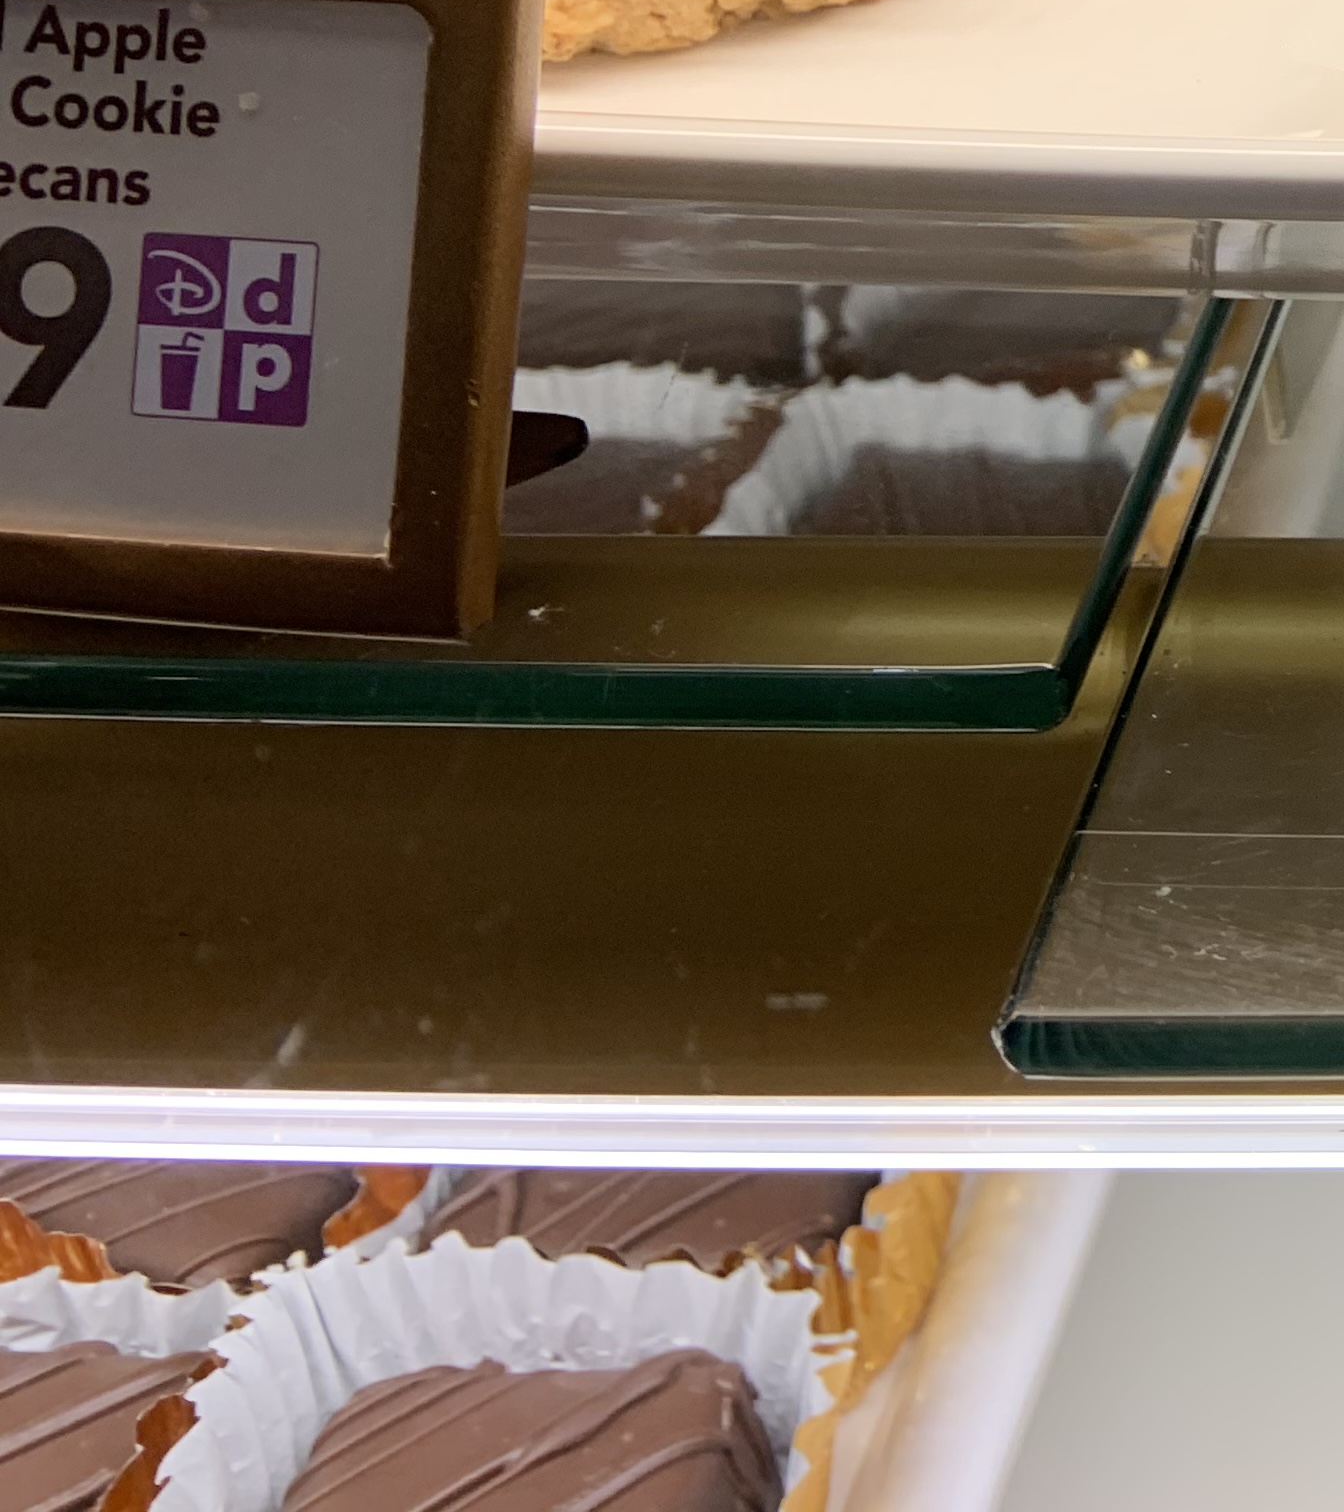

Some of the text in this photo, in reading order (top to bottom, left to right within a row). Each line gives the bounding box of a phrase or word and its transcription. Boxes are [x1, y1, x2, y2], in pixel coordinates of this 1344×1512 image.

[23, 4, 207, 74] Apple
[11, 75, 221, 137] Cookie
[0, 161, 151, 206] ecans
